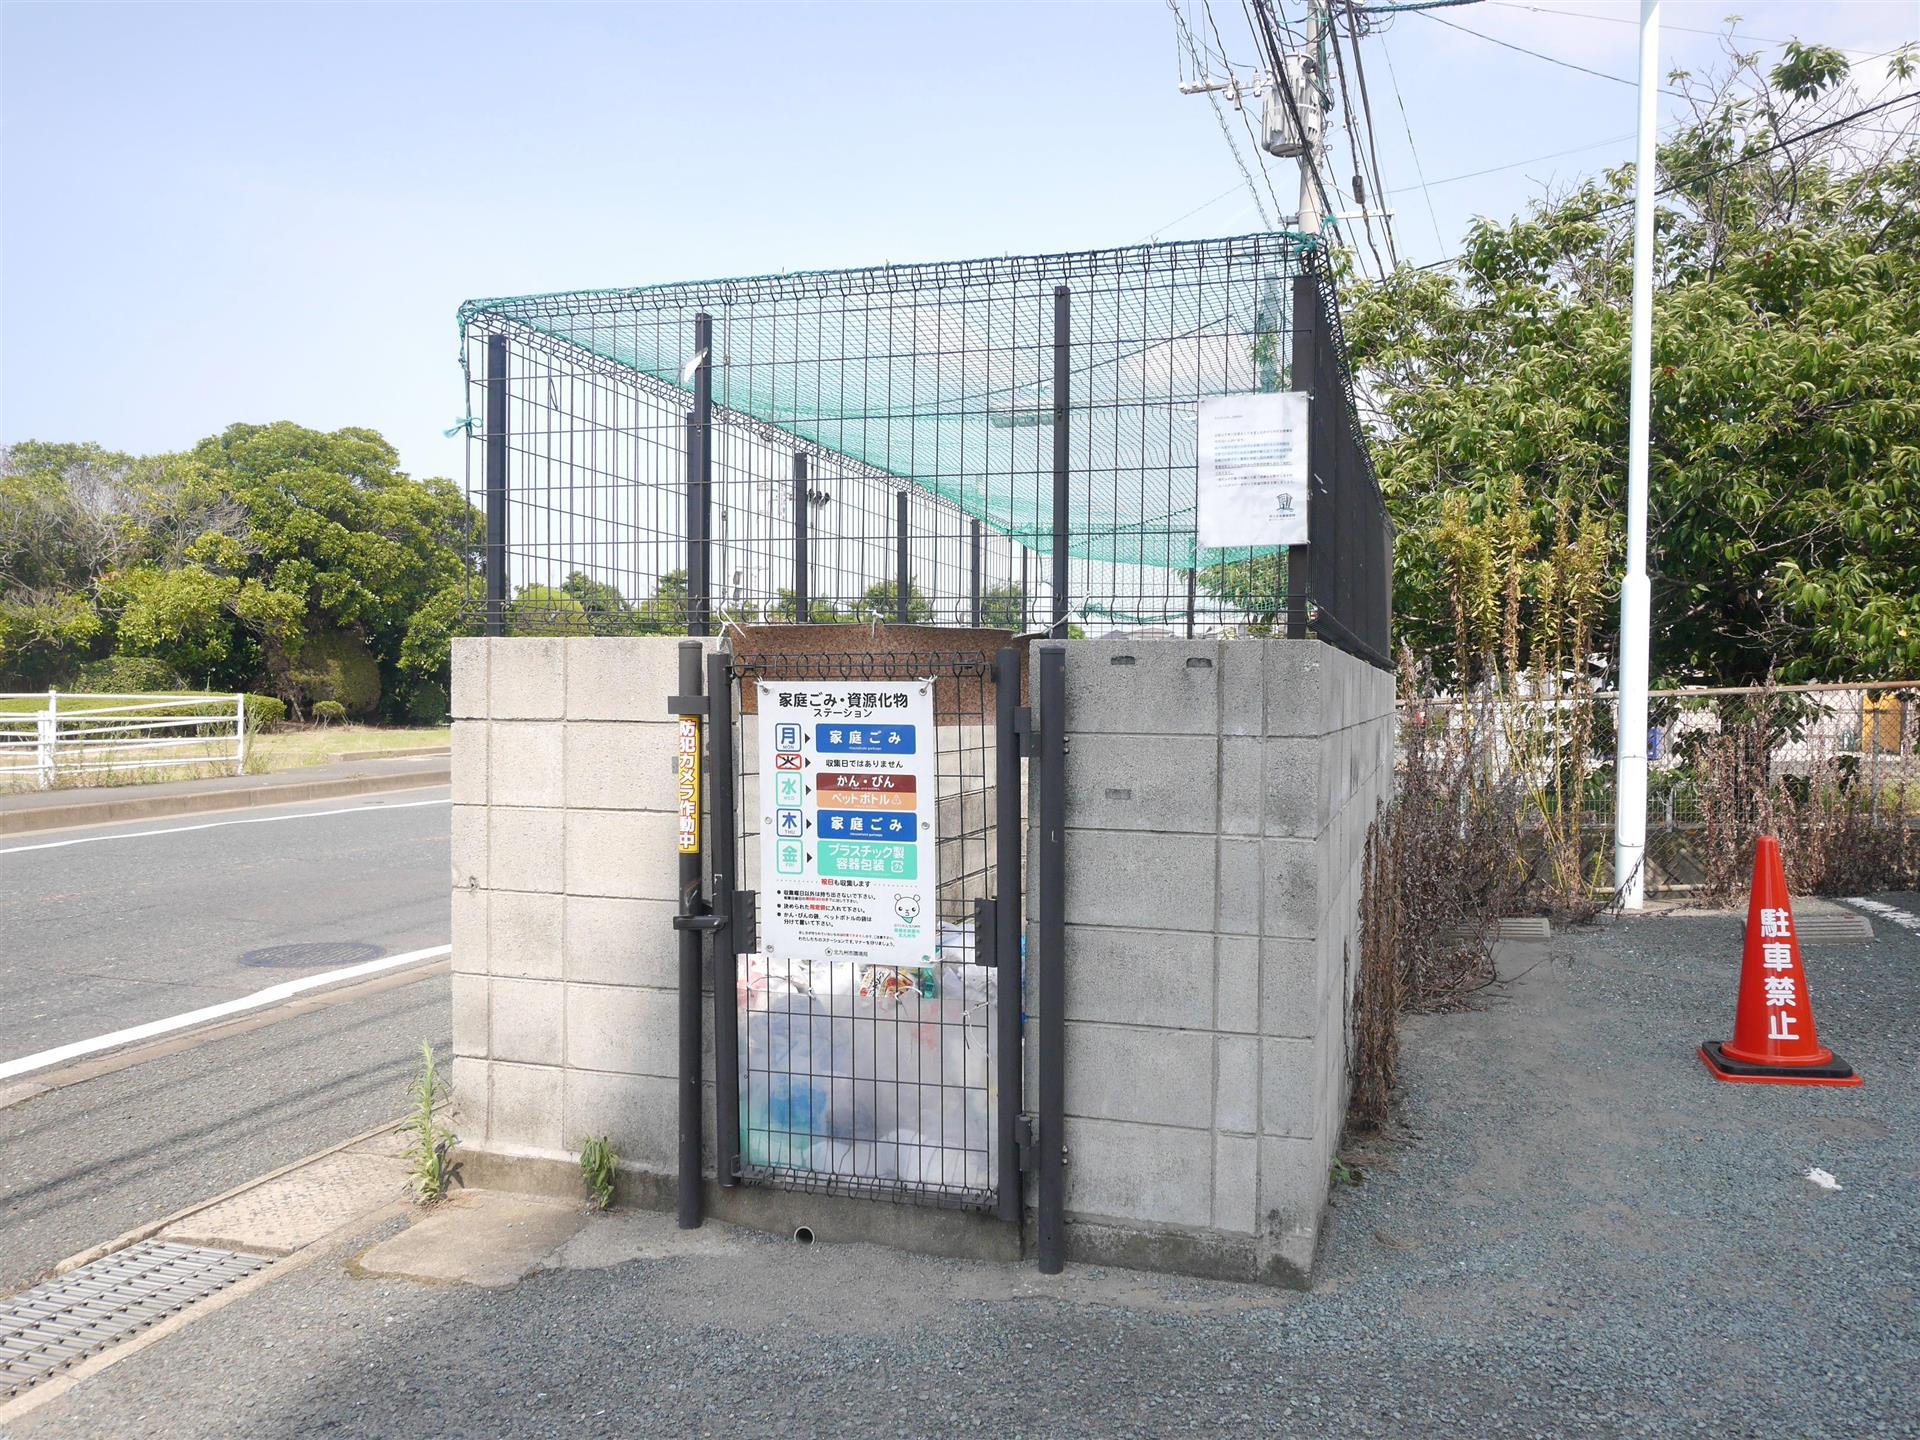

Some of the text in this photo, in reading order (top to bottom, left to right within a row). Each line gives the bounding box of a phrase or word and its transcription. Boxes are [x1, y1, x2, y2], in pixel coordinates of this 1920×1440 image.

[779, 692, 908, 709] 家庭ごみ・資源化物
[813, 708, 873, 718] ステーション
[781, 728, 796, 745] 月
[829, 730, 902, 745] 家庭ごみ
[783, 756, 796, 768] 火
[825, 760, 904, 769] 収集日ではありません
[679, 720, 697, 850] 防犯カメラ作動中
[781, 778, 797, 795] 水
[836, 775, 895, 789] かん・びん
[831, 793, 890, 806] ペットボトル
[782, 812, 798, 829] 木
[830, 816, 903, 832] 家庭ごみ
[782, 845, 798, 863] 金
[828, 843, 905, 859] プラスチック製
[836, 857, 885, 872] 容器包装
[821, 879, 871, 887] 祝日も収集します
[1760, 907, 1800, 1041] 駐車禁止
